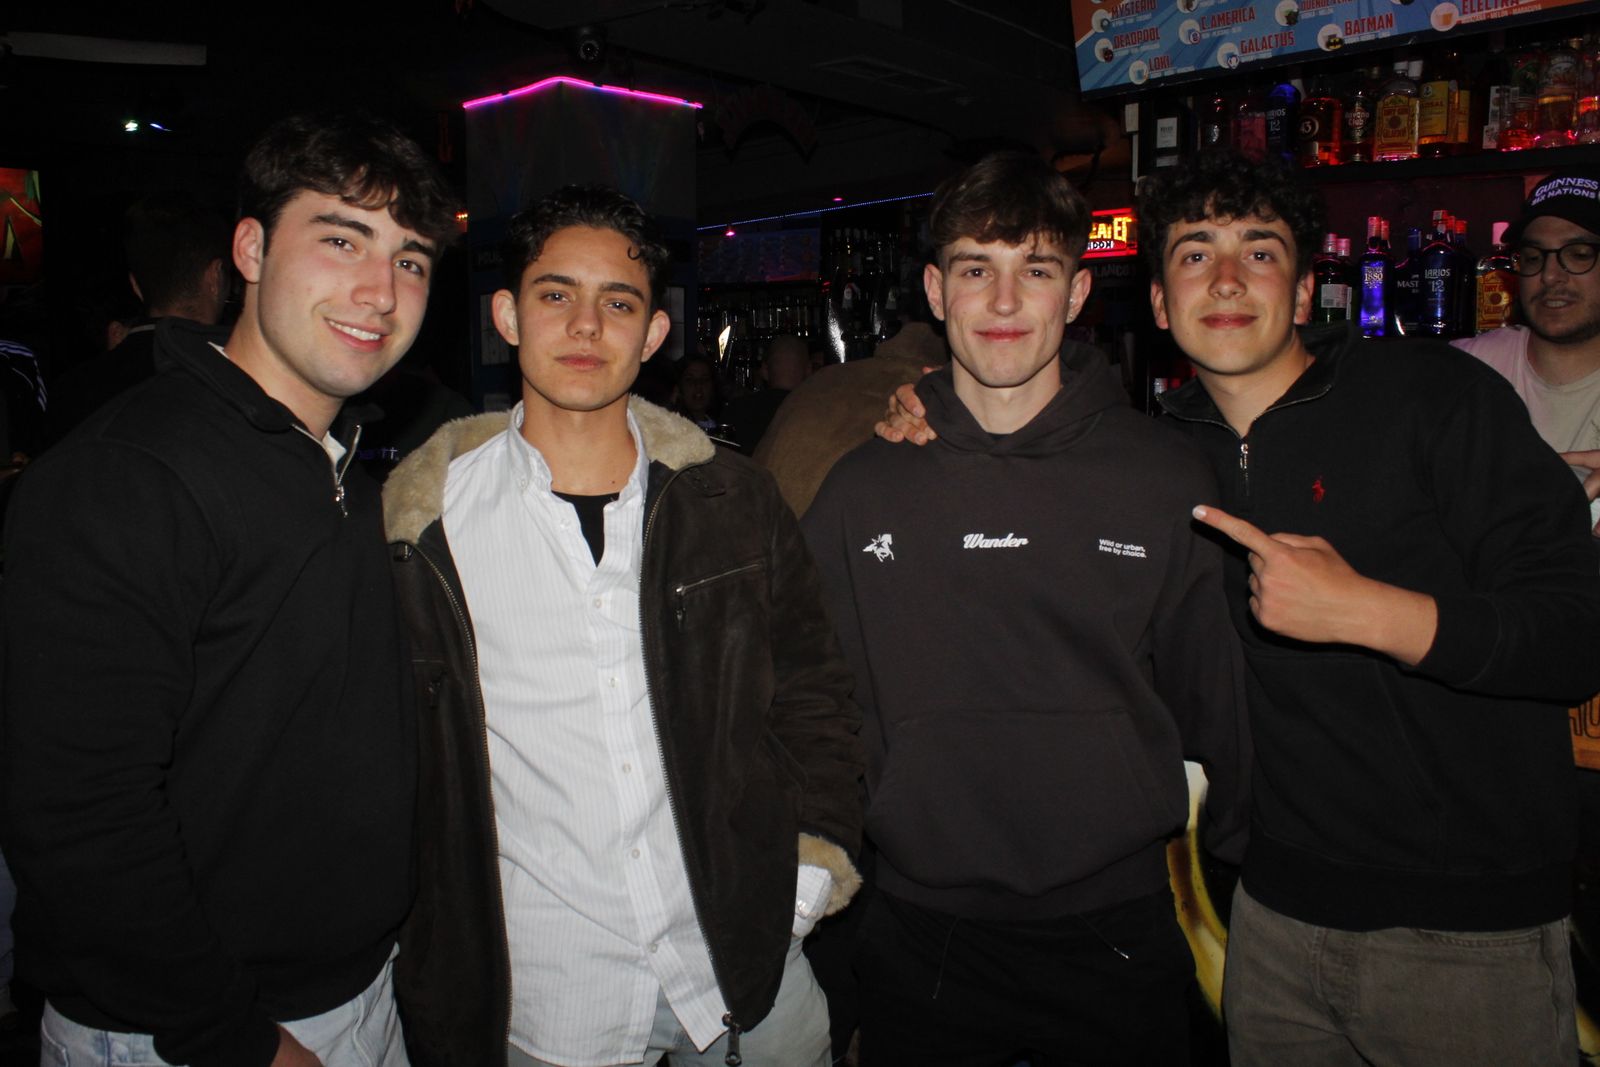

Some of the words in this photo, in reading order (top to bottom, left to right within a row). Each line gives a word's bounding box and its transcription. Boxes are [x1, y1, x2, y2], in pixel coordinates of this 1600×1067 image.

[1462, 0, 1519, 14] ELECTR
[1345, 13, 1393, 35] BATMAN
[1113, 26, 1160, 48] DEADPOOL
[1240, 31, 1295, 54] GALACTUS
[1149, 56, 1171, 71] LOKI
[1535, 177, 1599, 197] GUINNESS
[1547, 187, 1596, 199] NATIONS
[1425, 268, 1451, 279] LARIOS
[1431, 279, 1445, 292] 12
[963, 533, 1029, 549] Wander
[1099, 539, 1114, 547] Wild
[1099, 545, 1112, 553] free
[1113, 547, 1122, 556] by
